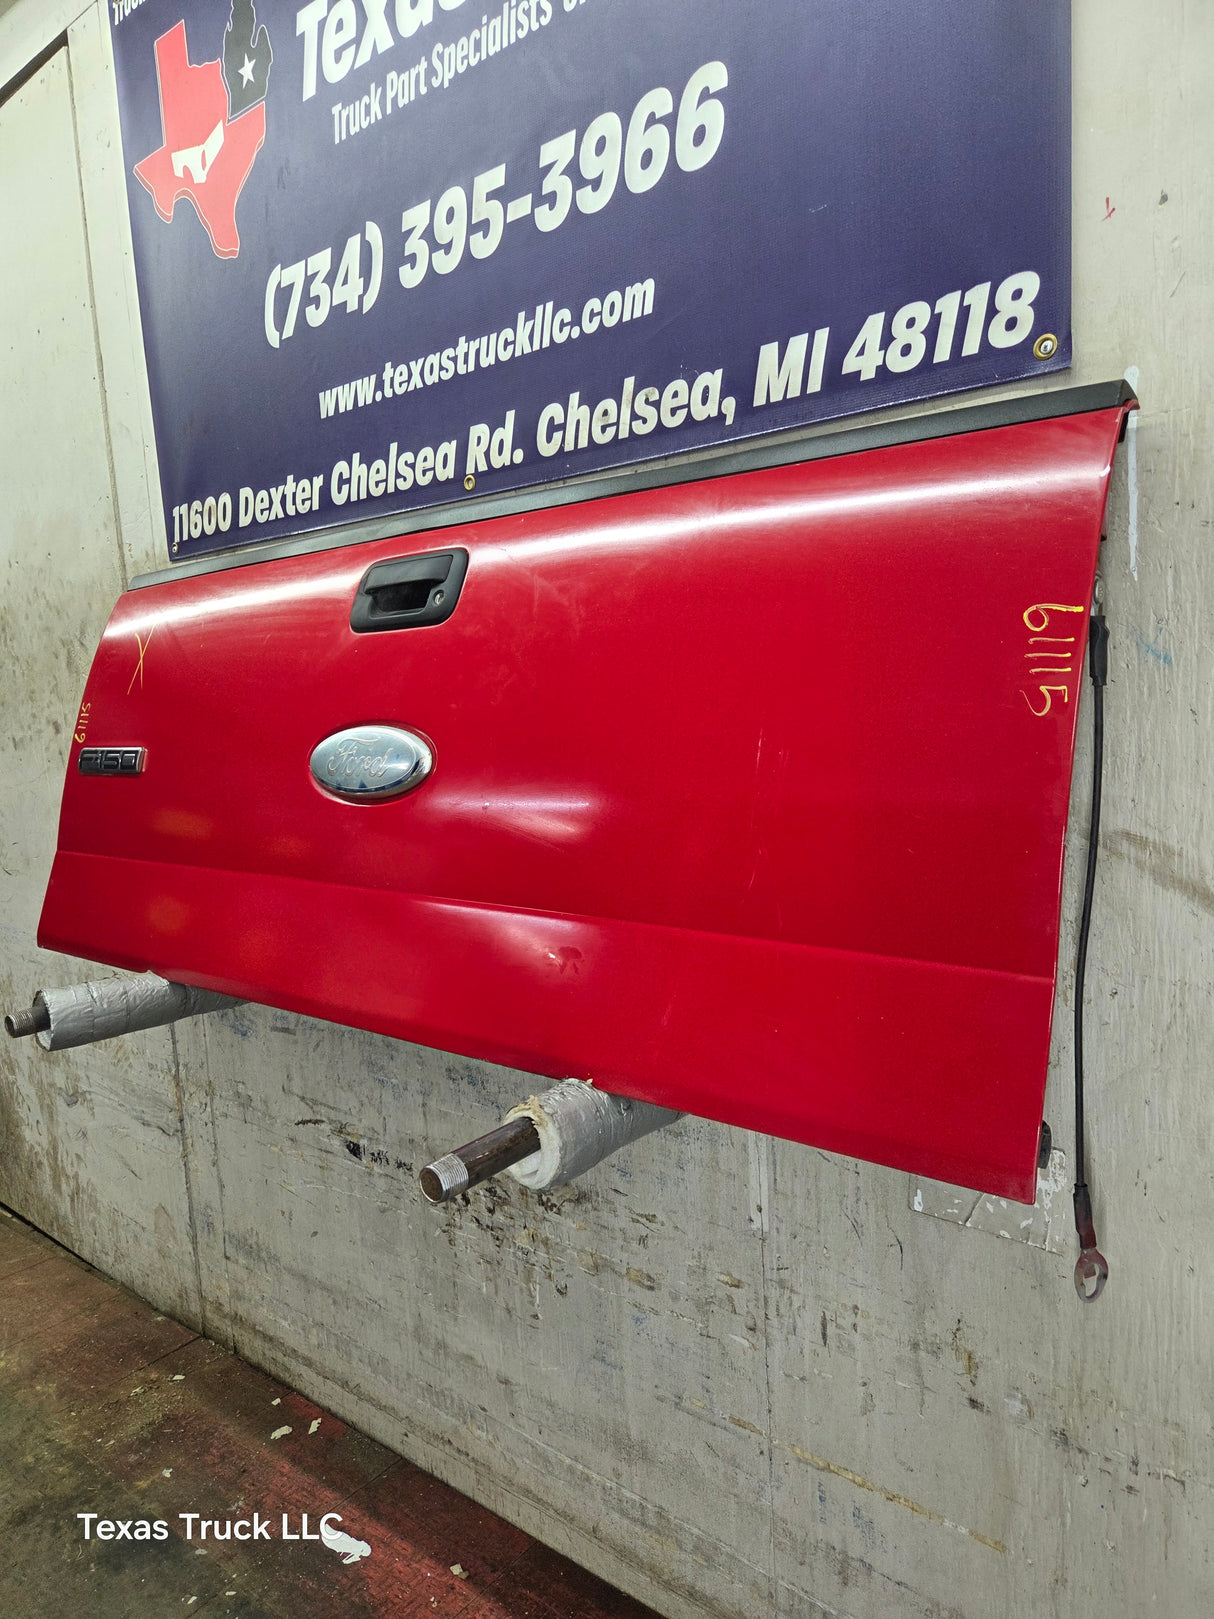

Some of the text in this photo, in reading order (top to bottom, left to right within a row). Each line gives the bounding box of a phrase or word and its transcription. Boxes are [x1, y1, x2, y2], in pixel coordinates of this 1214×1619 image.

[332, 0, 553, 145] Truck Part Specialists
[264, 61, 729, 348] (734) 395-3966
[172, 270, 1041, 543] 11600 Dexter Chelsea Rd. Chelsea, MI 48118
[318, 278, 656, 419] www.texastruckllc.com
[1020, 603, 1084, 716] 61115
[327, 736, 394, 776] Ford
